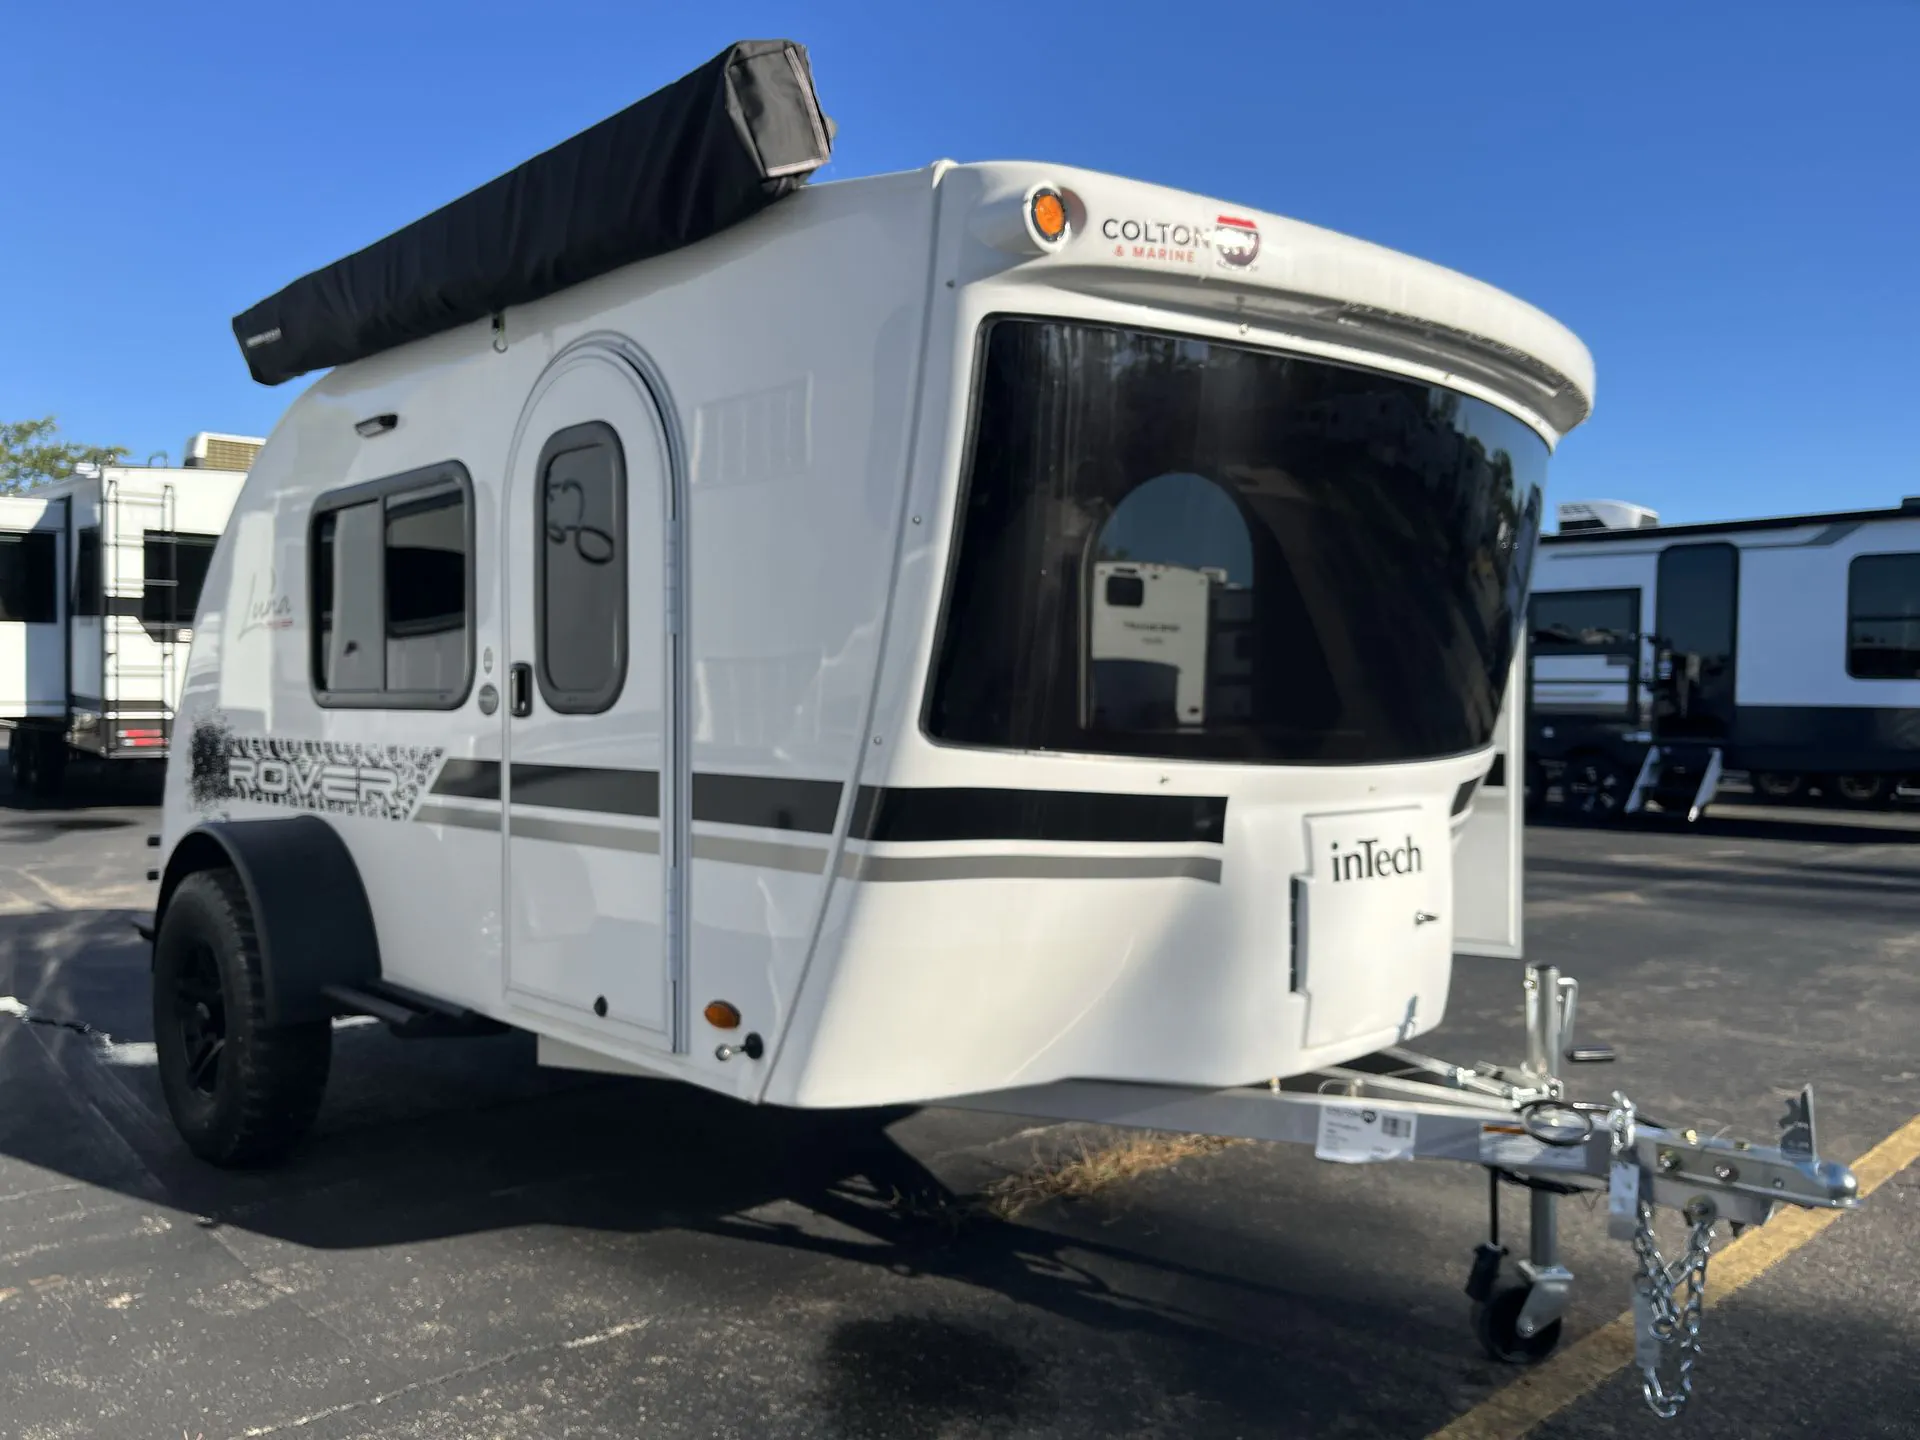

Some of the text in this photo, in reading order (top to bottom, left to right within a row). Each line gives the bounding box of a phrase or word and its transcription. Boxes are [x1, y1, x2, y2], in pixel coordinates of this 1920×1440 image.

[1102, 218, 1210, 249] COLTON
[1132, 246, 1195, 263] MARINE
[228, 757, 399, 807] ROVER
[1331, 833, 1422, 882] inTech
